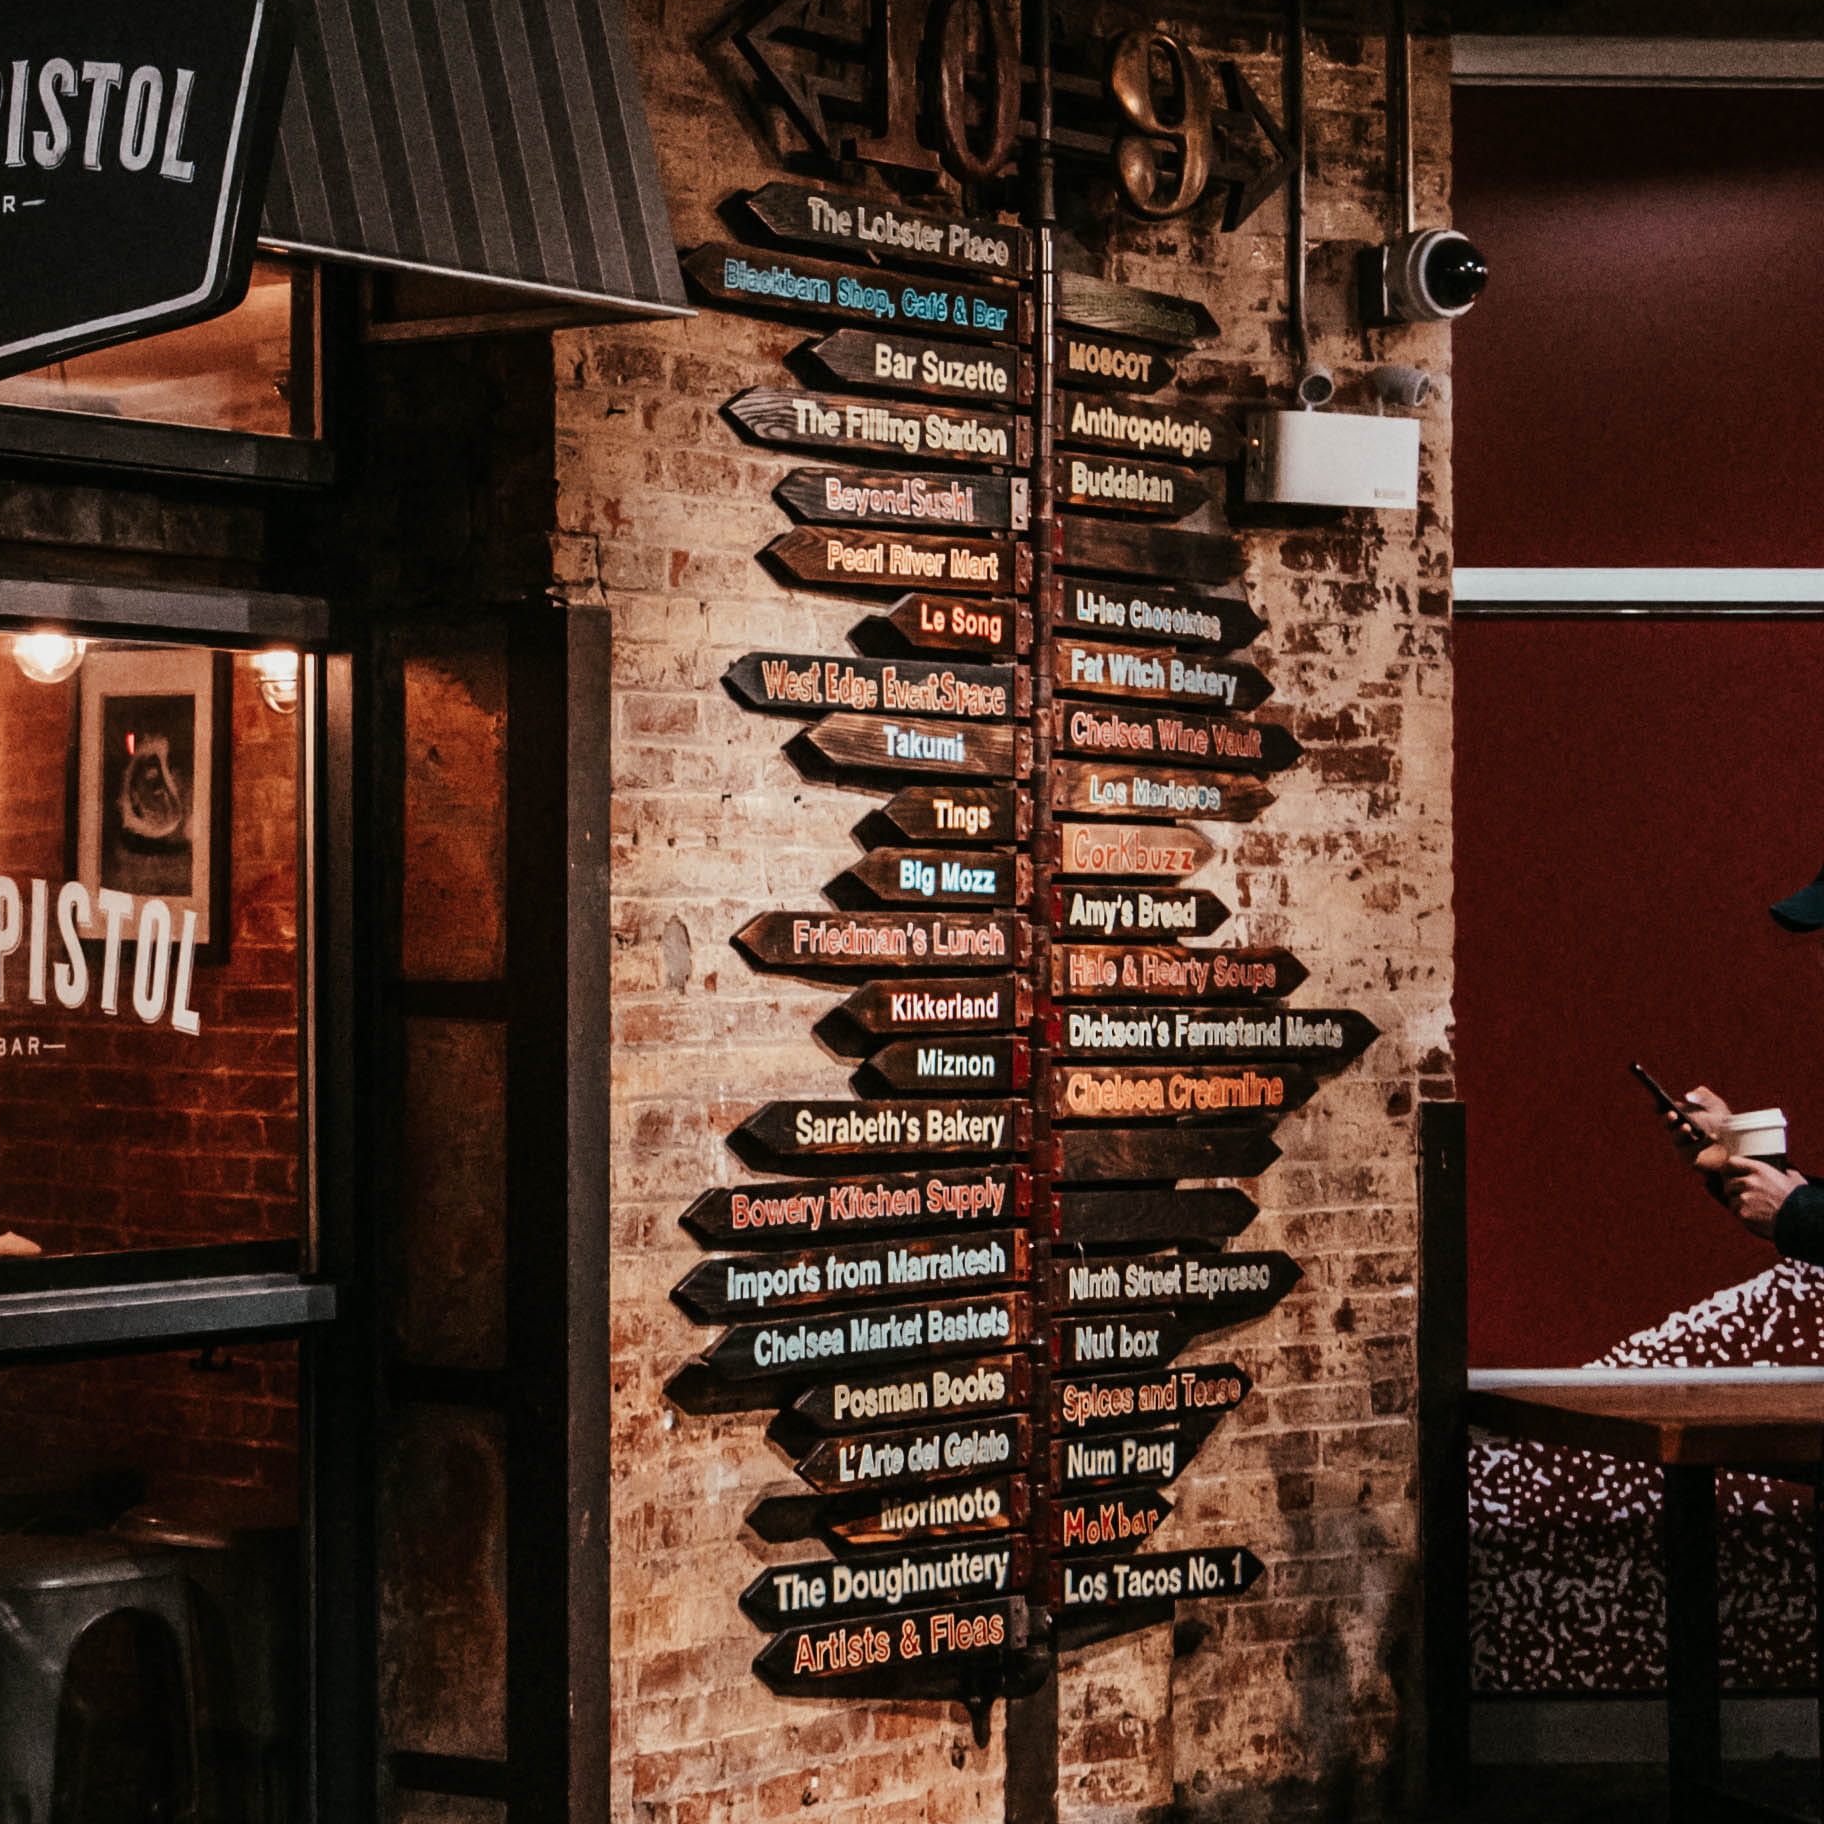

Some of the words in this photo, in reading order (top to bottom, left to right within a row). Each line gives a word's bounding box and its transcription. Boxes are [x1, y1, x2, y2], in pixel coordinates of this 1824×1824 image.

[1111, 31, 1212, 220] 9
[807, 196, 854, 237] The
[857, 206, 944, 254] Lobster
[948, 225, 1009, 267] Place
[724, 258, 831, 305] Blackbarn
[836, 277, 896, 319] Shop,
[901, 287, 949, 323] Café
[954, 298, 969, 326] &
[972, 297, 1008, 332] Bar
[875, 343, 916, 380] Bar
[921, 350, 1008, 394] Suzette
[1069, 341, 1152, 383] MOSCOT
[792, 398, 840, 437] The
[845, 405, 921, 452] Filling
[924, 416, 1008, 457] Station
[1071, 401, 1213, 457] Anthropologie
[1071, 460, 1174, 504] Buddakan
[826, 539, 884, 574] Pearl
[889, 543, 945, 576] River
[949, 547, 1000, 582] Mart
[920, 603, 945, 631] Le
[950, 606, 1002, 644] Song
[761, 660, 823, 705] West
[824, 663, 878, 711] Edge
[1070, 648, 1105, 684] Fat
[1108, 652, 1166, 690] Witch
[1170, 659, 1238, 707] Bakery
[882, 725, 965, 762] Takumi
[1069, 711, 1153, 750] Chelsea
[1157, 718, 1209, 755] Wine
[1211, 724, 1262, 759] Vault
[932, 798, 992, 834] Tings
[1089, 775, 1128, 810] Los
[1132, 777, 1222, 816] Mariscos
[898, 859, 937, 897] Big
[940, 862, 998, 894] Mozz
[1069, 893, 1135, 935] Amy's
[1138, 895, 1197, 929] Bread
[792, 920, 927, 957] Friedman's
[932, 922, 1007, 956] Lunch
[1069, 953, 1118, 987] Hale
[1122, 955, 1140, 985] &
[1142, 953, 1212, 996] Hearty
[1214, 956, 1277, 994] Soups
[890, 991, 1000, 1023] Kikkerland
[1068, 1014, 1170, 1048] Dickson's
[1175, 1015, 1281, 1048] Farmstand
[1285, 1016, 1344, 1049] Meats
[916, 1048, 997, 1077] Miznon
[1066, 1072, 1165, 1115] Chelsea
[1168, 1071, 1285, 1111] Creamline
[795, 1109, 922, 1146] Sarabeth's
[926, 1109, 1006, 1150] Bakery
[731, 1191, 826, 1231] Bowery
[829, 1183, 922, 1222] Kitchen
[926, 1175, 1007, 1220] Supply
[726, 1259, 821, 1307] Imports
[825, 1254, 883, 1292] from
[886, 1240, 1007, 1284] Marrakesh
[1069, 1265, 1121, 1301] Ninth
[1124, 1261, 1183, 1298] Street
[1185, 1261, 1272, 1302] Espresso
[754, 1325, 846, 1369] Chelsea
[849, 1313, 924, 1353] Market
[927, 1306, 1011, 1344] Baskets
[1075, 1325, 1115, 1362] Nut
[1119, 1322, 1161, 1358] box
[833, 1380, 930, 1420] Posman
[932, 1367, 1007, 1408] Books
[1062, 1384, 1135, 1428] Spices
[1138, 1373, 1177, 1414] and
[1180, 1371, 1242, 1410] Tease
[838, 1441, 906, 1483] L'Arte
[907, 1435, 942, 1473] del
[943, 1429, 1010, 1470] Gelato
[1066, 1442, 1117, 1480] Num
[1121, 1437, 1176, 1477] Pang
[879, 1485, 1002, 1532] Morimoto
[773, 1572, 827, 1613] The
[832, 1550, 1011, 1606] Doughnuttery
[1063, 1566, 1109, 1606] Los
[1112, 1560, 1183, 1600] Tacos
[1187, 1554, 1226, 1592] No.
[1231, 1551, 1244, 1586] 1
[792, 1626, 891, 1675] Artists
[898, 1618, 922, 1659] &
[929, 1612, 1005, 1656] Fleas
